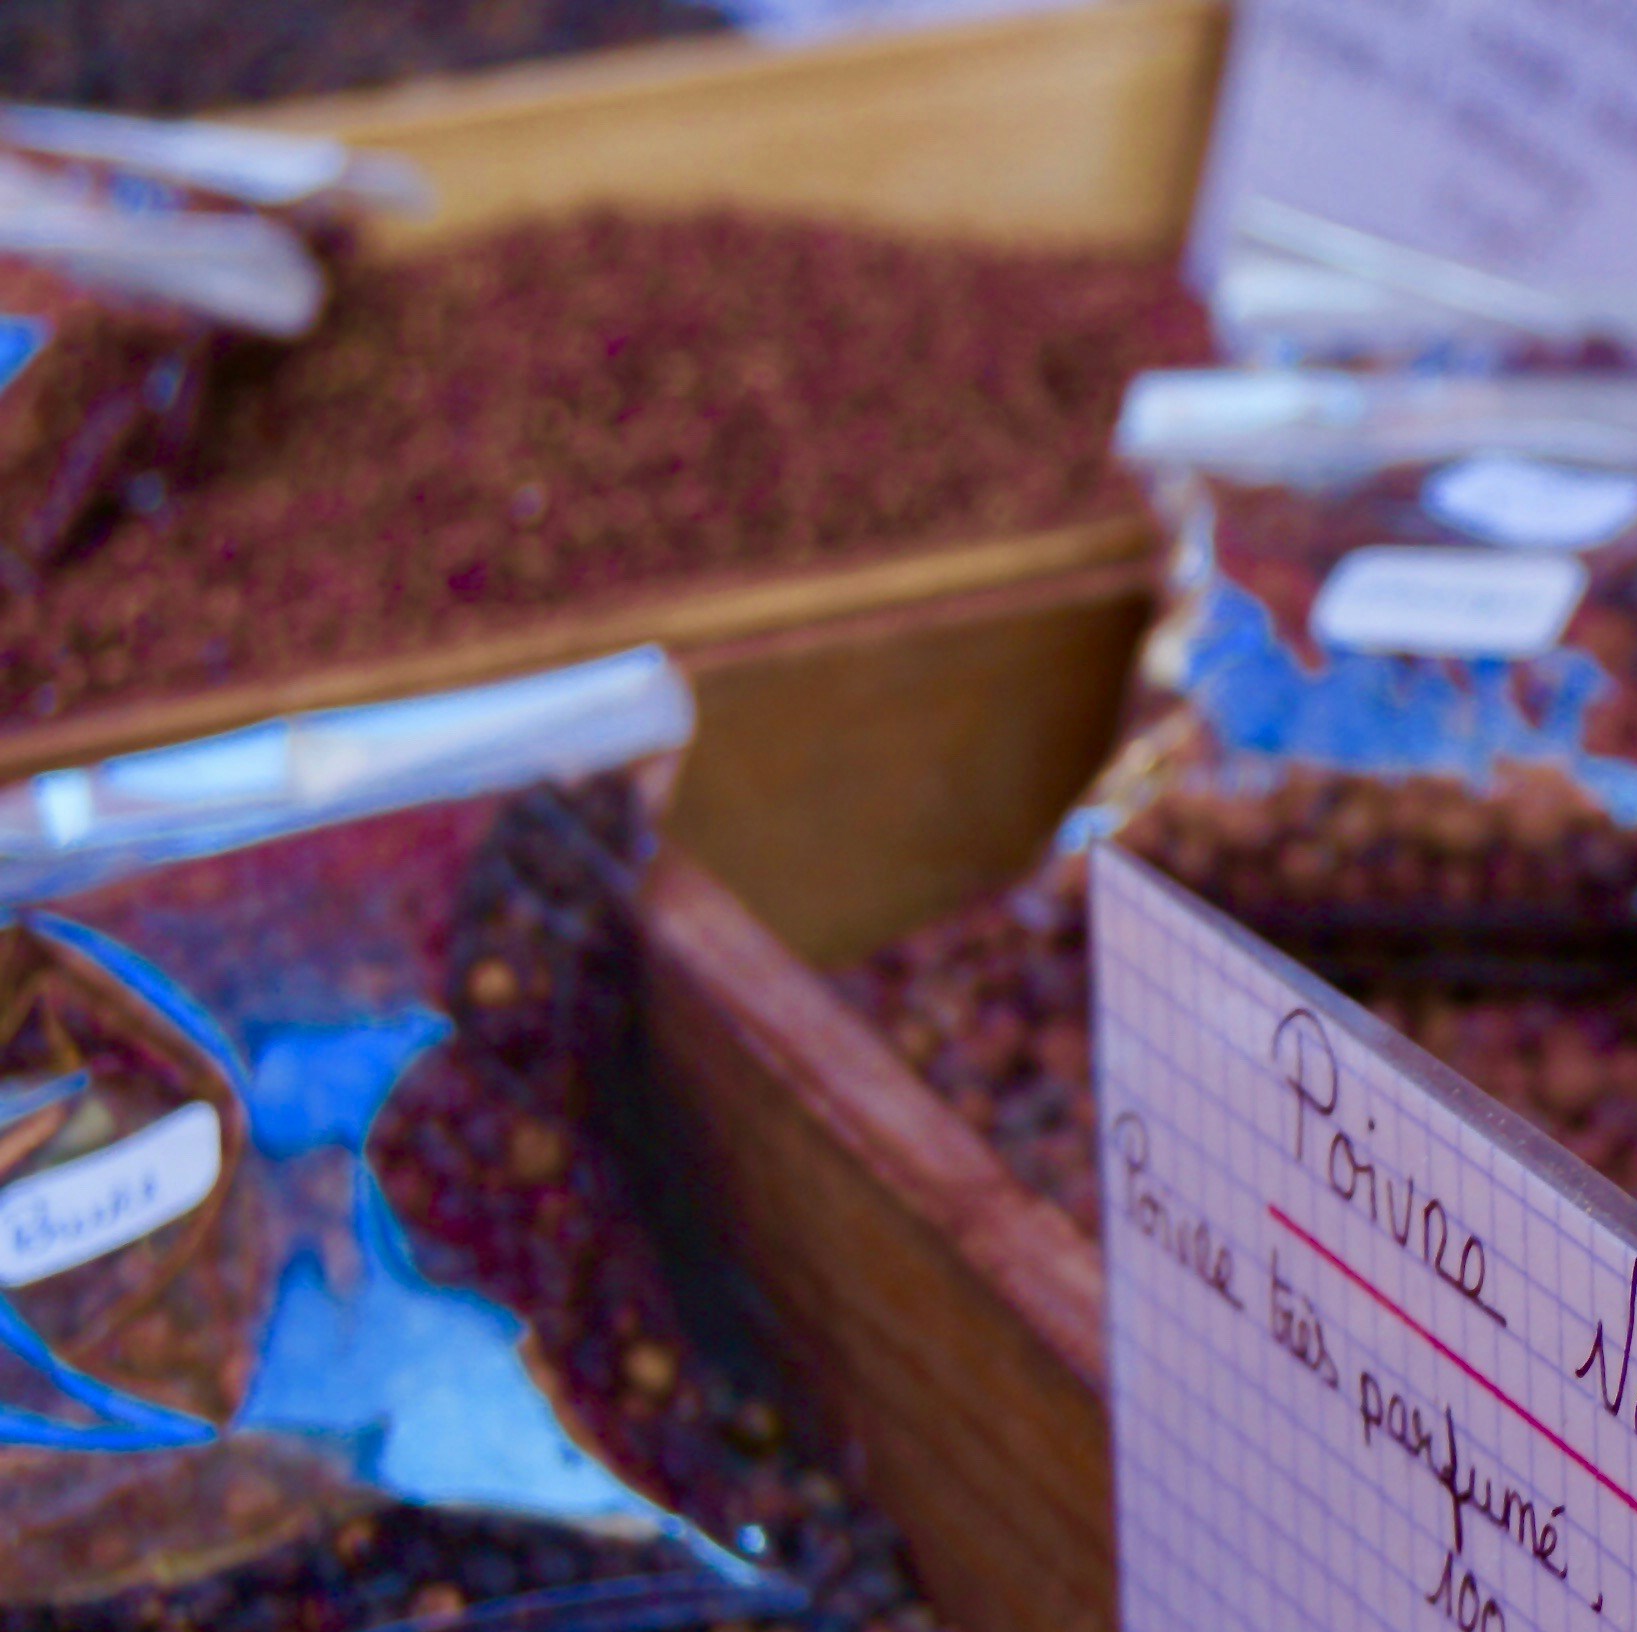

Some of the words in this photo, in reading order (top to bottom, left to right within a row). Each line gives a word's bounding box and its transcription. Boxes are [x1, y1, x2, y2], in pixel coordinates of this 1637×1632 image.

[1112, 1110, 1245, 1313] Poivre
[1268, 1246, 1340, 1390] très
[1271, 1007, 1508, 1329] Poivre
